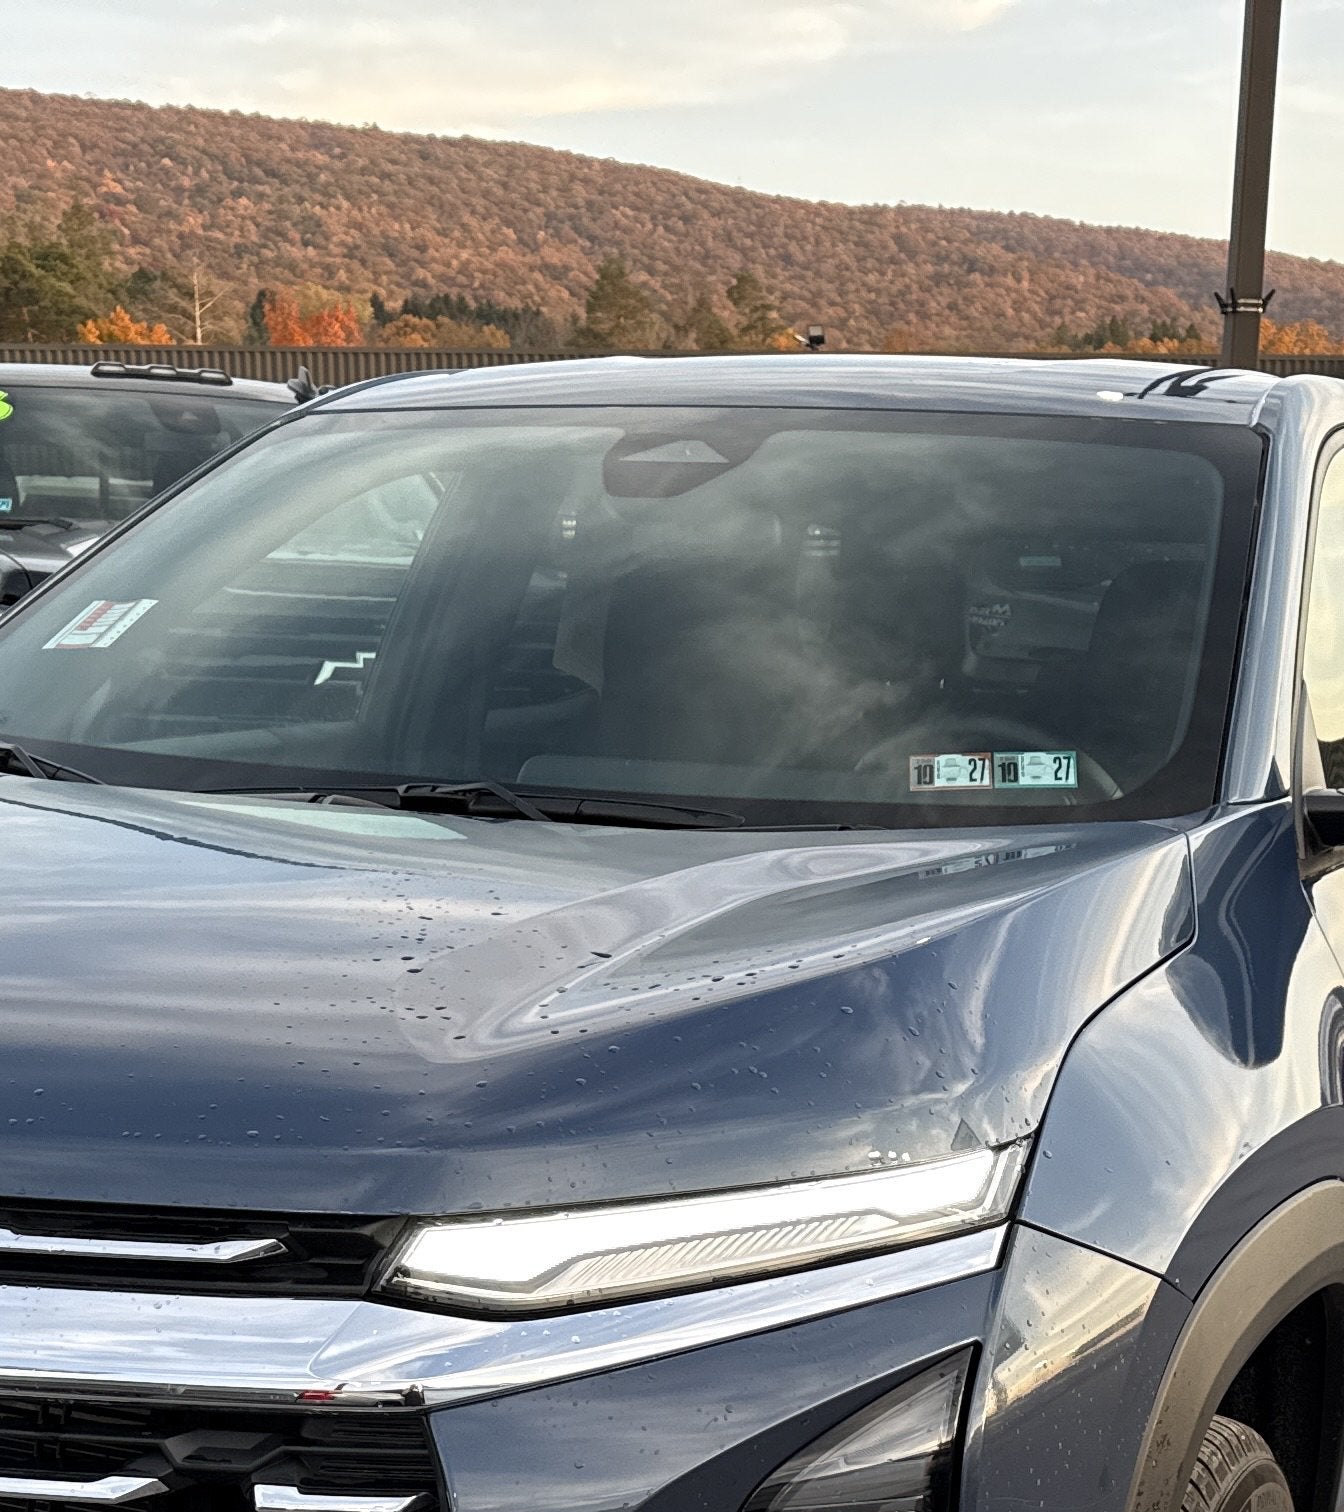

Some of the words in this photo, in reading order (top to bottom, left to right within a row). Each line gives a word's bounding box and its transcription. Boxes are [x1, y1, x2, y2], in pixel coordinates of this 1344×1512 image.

[914, 764, 935, 785] 10
[968, 758, 986, 783] 27
[998, 762, 1018, 783] 10
[1053, 756, 1071, 782] 27
